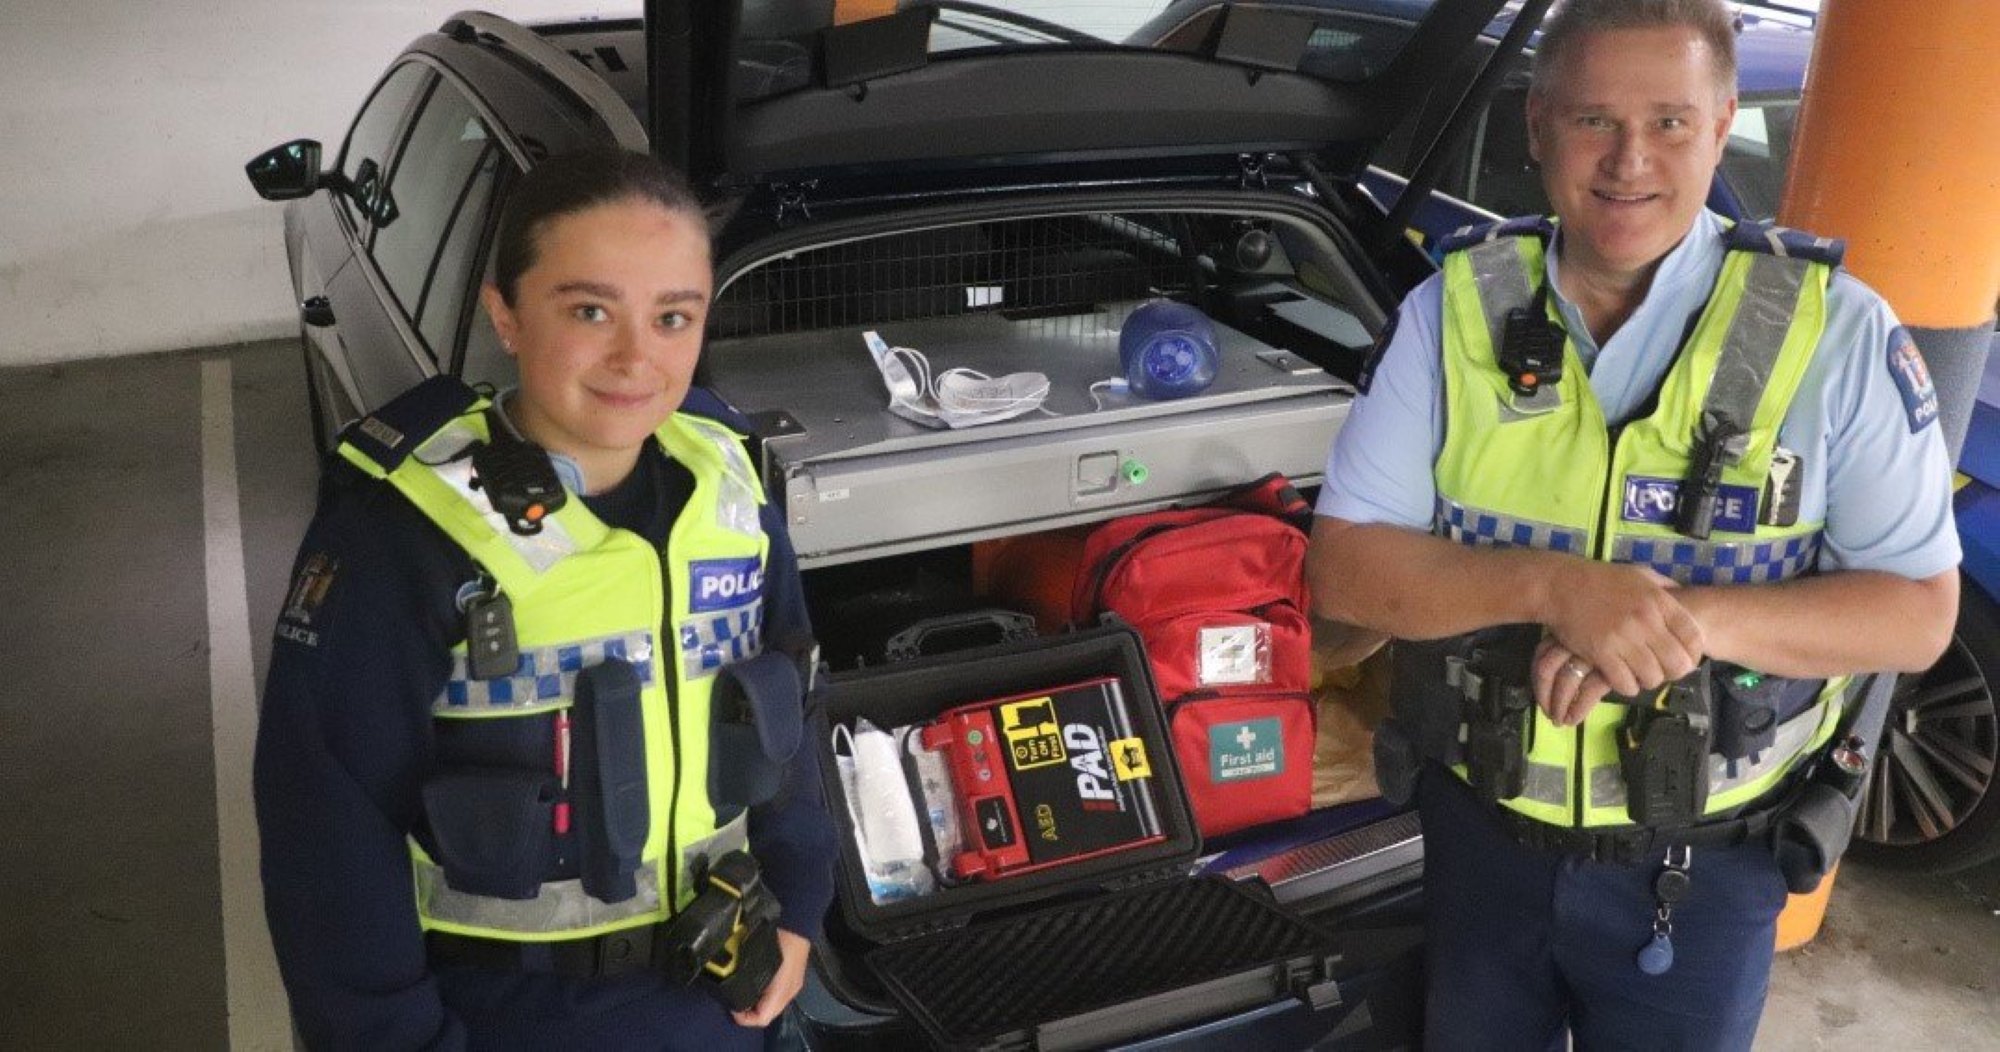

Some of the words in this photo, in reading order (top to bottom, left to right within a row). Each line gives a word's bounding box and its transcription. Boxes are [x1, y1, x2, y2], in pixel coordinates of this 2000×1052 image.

[1638, 488, 1742, 519] POCE
[702, 569, 764, 599] POLIC
[1029, 740, 1039, 761] Turn
[1221, 753, 1251, 767] First
[1255, 747, 1275, 763] aid
[1036, 804, 1058, 840] AED
